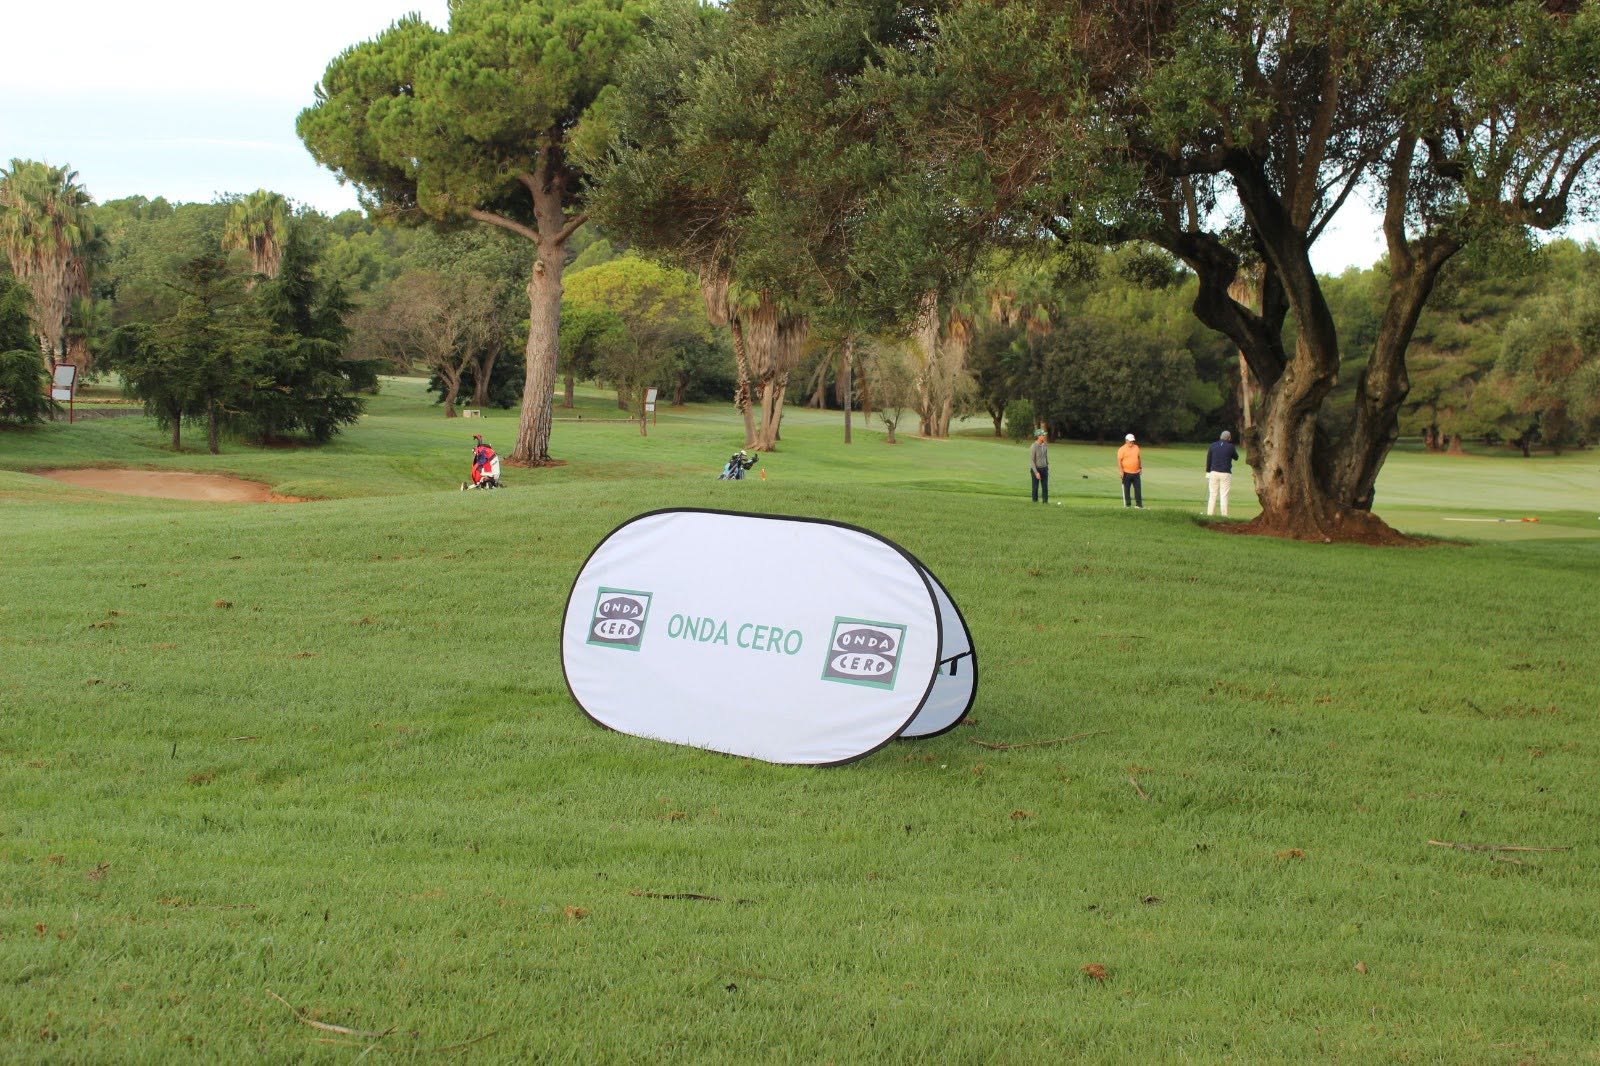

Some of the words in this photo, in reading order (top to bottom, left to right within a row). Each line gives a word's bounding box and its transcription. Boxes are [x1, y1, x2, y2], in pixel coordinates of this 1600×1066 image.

[603, 602, 639, 615] ONDA
[600, 622, 635, 636] CERO
[668, 613, 729, 646] ONDA
[736, 623, 803, 656] CERO
[842, 634, 890, 649] ONDA
[839, 656, 885, 673] CERO
